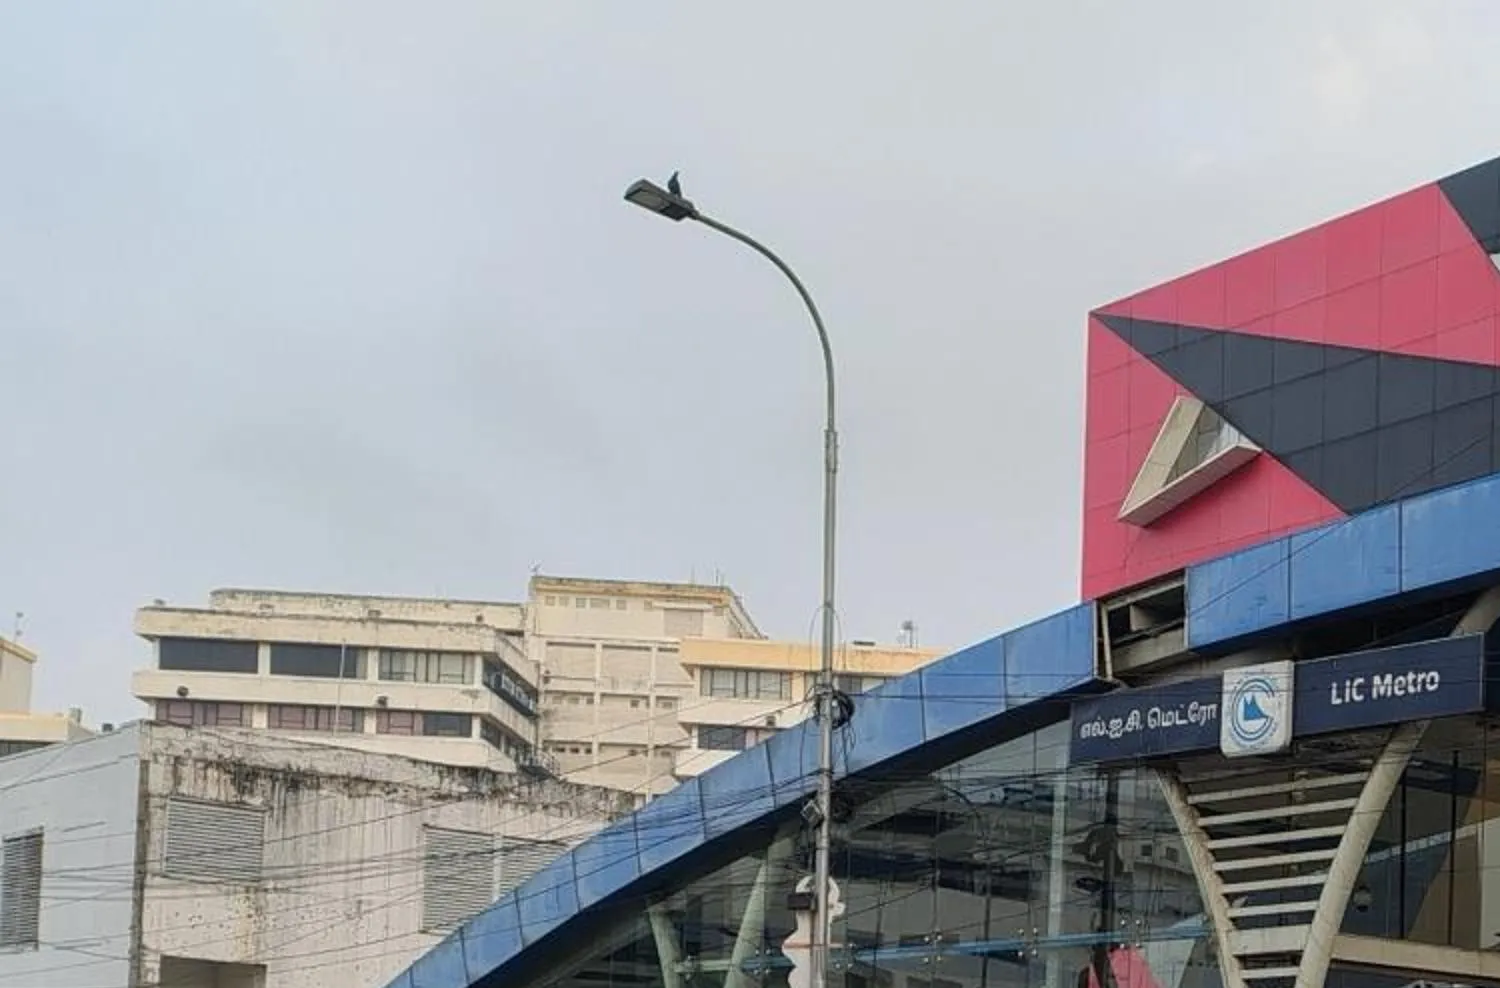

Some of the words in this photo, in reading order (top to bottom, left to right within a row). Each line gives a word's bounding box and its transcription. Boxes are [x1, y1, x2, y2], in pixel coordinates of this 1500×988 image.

[1331, 678, 1365, 705] LIC
[1372, 670, 1440, 699] Metro
[1147, 701, 1219, 729] மெட்ரோ
